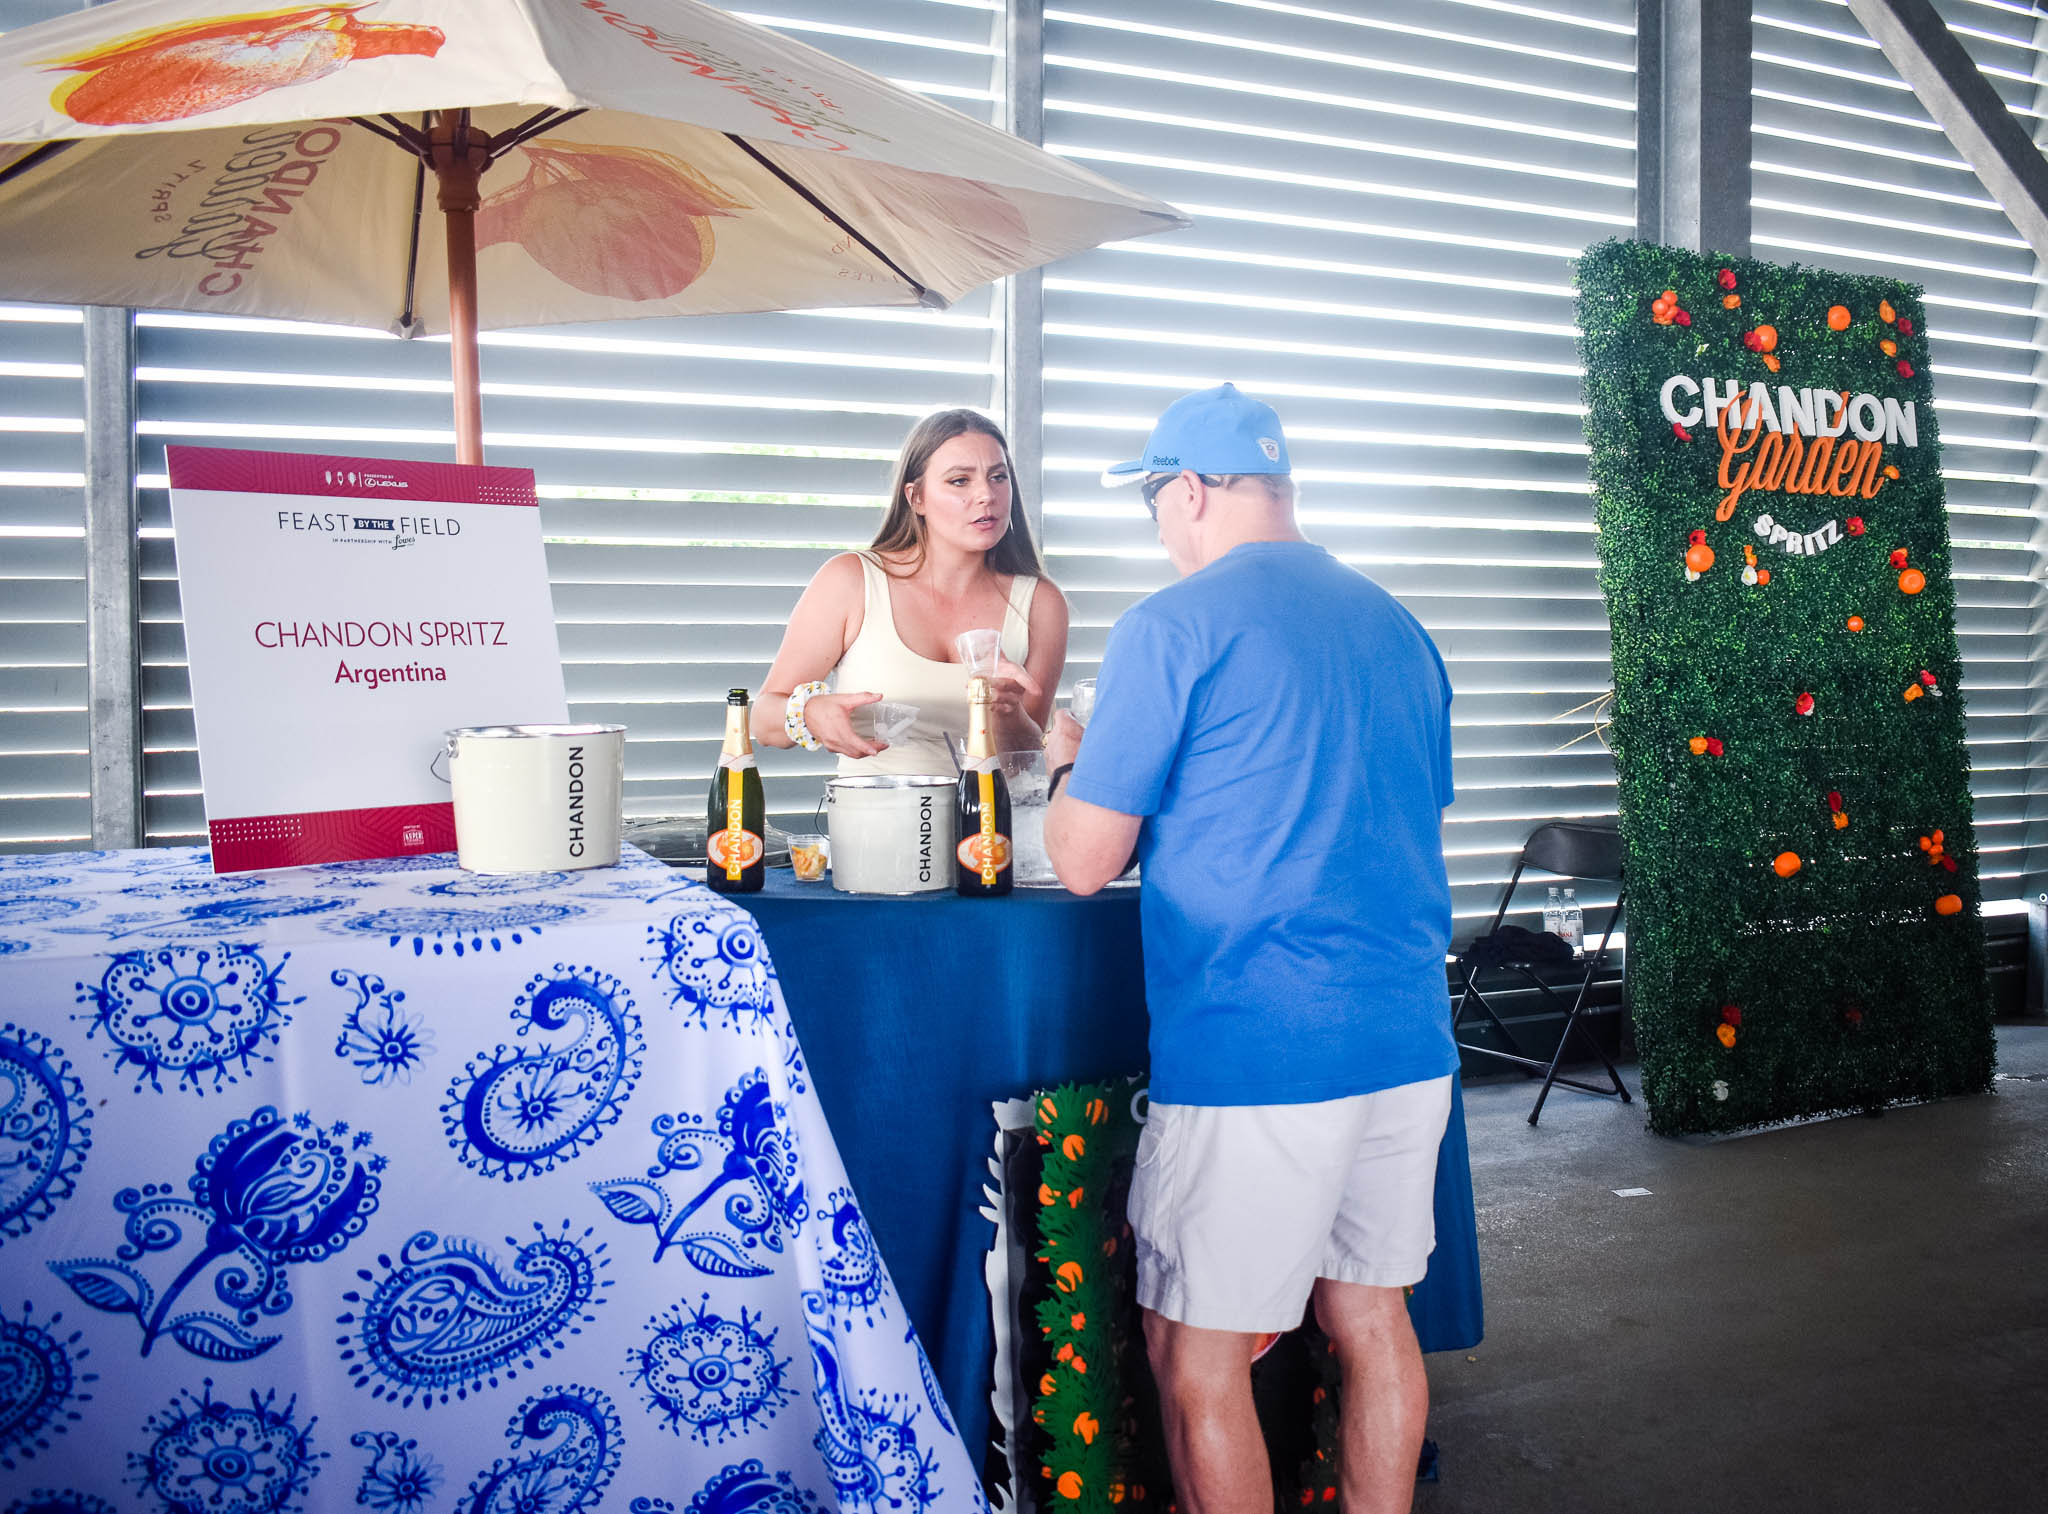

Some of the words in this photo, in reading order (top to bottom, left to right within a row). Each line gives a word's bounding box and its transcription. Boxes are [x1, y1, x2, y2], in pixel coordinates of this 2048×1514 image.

[1660, 375, 1918, 447] CHANDON
[376, 480, 408, 488] LEXUS
[1152, 456, 1180, 466] Reebok
[1715, 391, 1884, 522] Garden
[278, 511, 349, 532] FEAST
[358, 520, 370, 528] BY
[371, 520, 390, 529] THE
[400, 517, 461, 536] FIELD
[1754, 514, 1843, 556] SPRITZ
[255, 621, 413, 648] CHANDON
[419, 621, 508, 647] SPRITZ
[334, 659, 447, 690] Argentina
[568, 746, 584, 858] CHANDON
[728, 800, 742, 876] CHANDON
[919, 795, 932, 883] CHANDON
[981, 802, 995, 880] CHANDON
